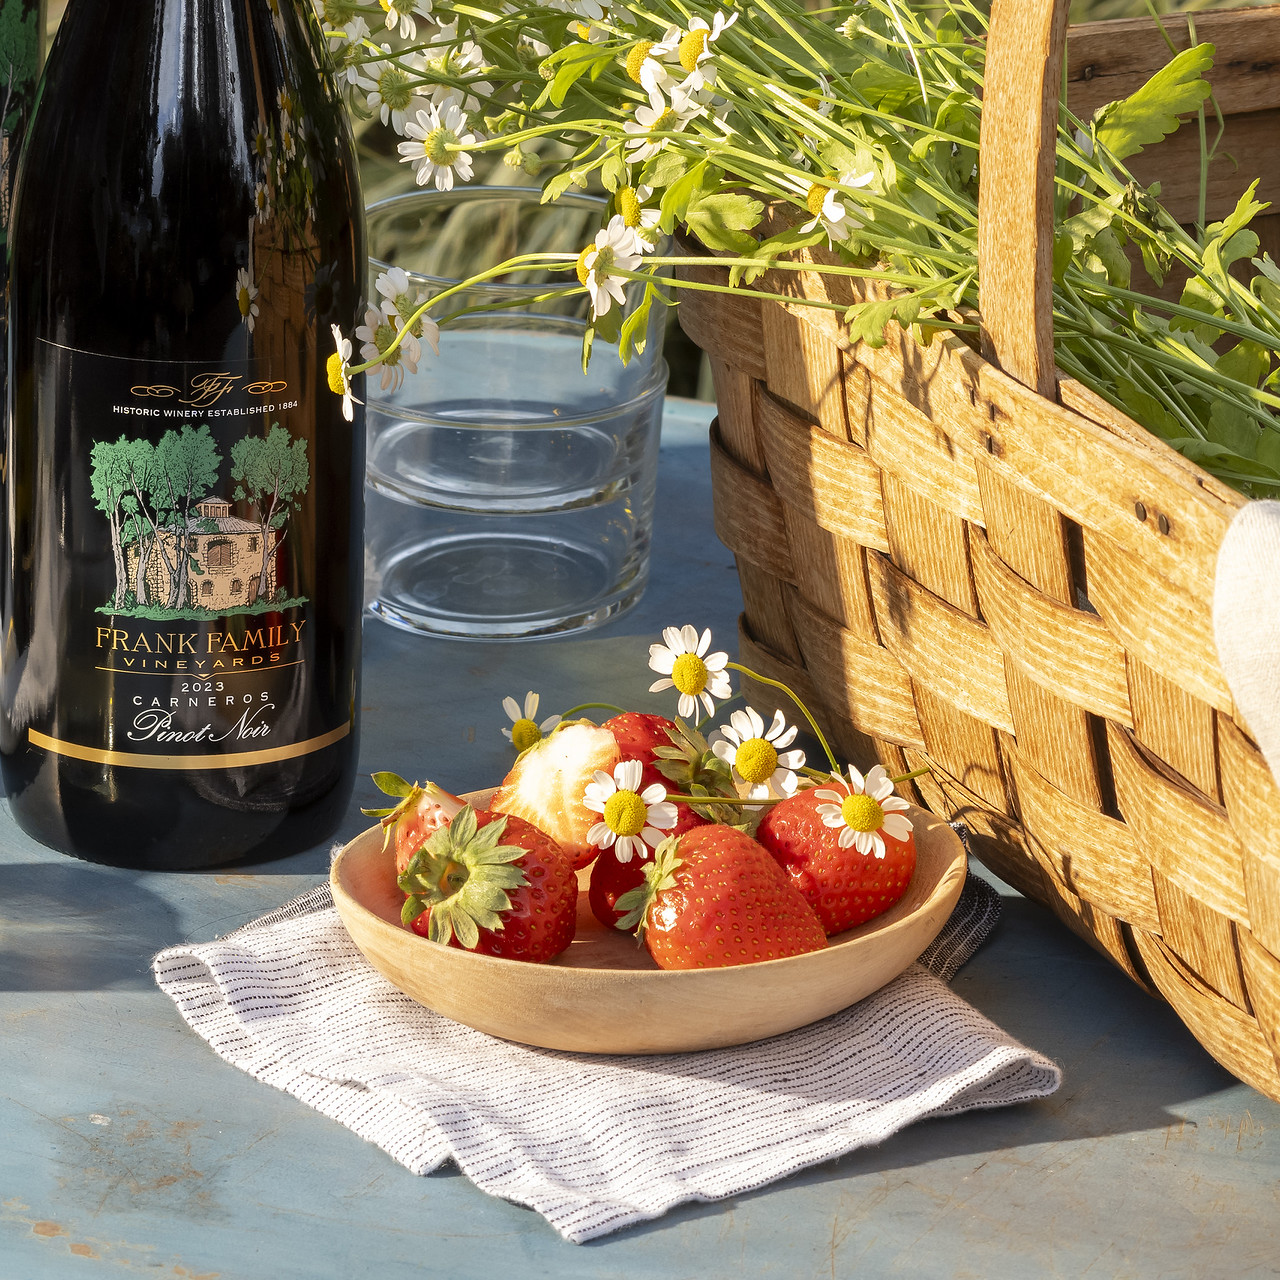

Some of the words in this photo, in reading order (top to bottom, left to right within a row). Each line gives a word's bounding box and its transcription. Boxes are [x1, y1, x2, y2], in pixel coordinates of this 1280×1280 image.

[112, 405, 160, 417] HISTORIC
[163, 409, 205, 418] WINERY
[207, 404, 275, 417] ESTABLISHED
[278, 400, 298, 411] 1884
[95, 626, 198, 654] FRANK
[206, 619, 307, 654] FAMILY
[123, 652, 281, 669] VINEYARDS
[181, 681, 225, 693] 2023
[133, 691, 269, 707] CARNEROS
[127, 708, 211, 743] Pinot
[208, 703, 276, 742] Noir
